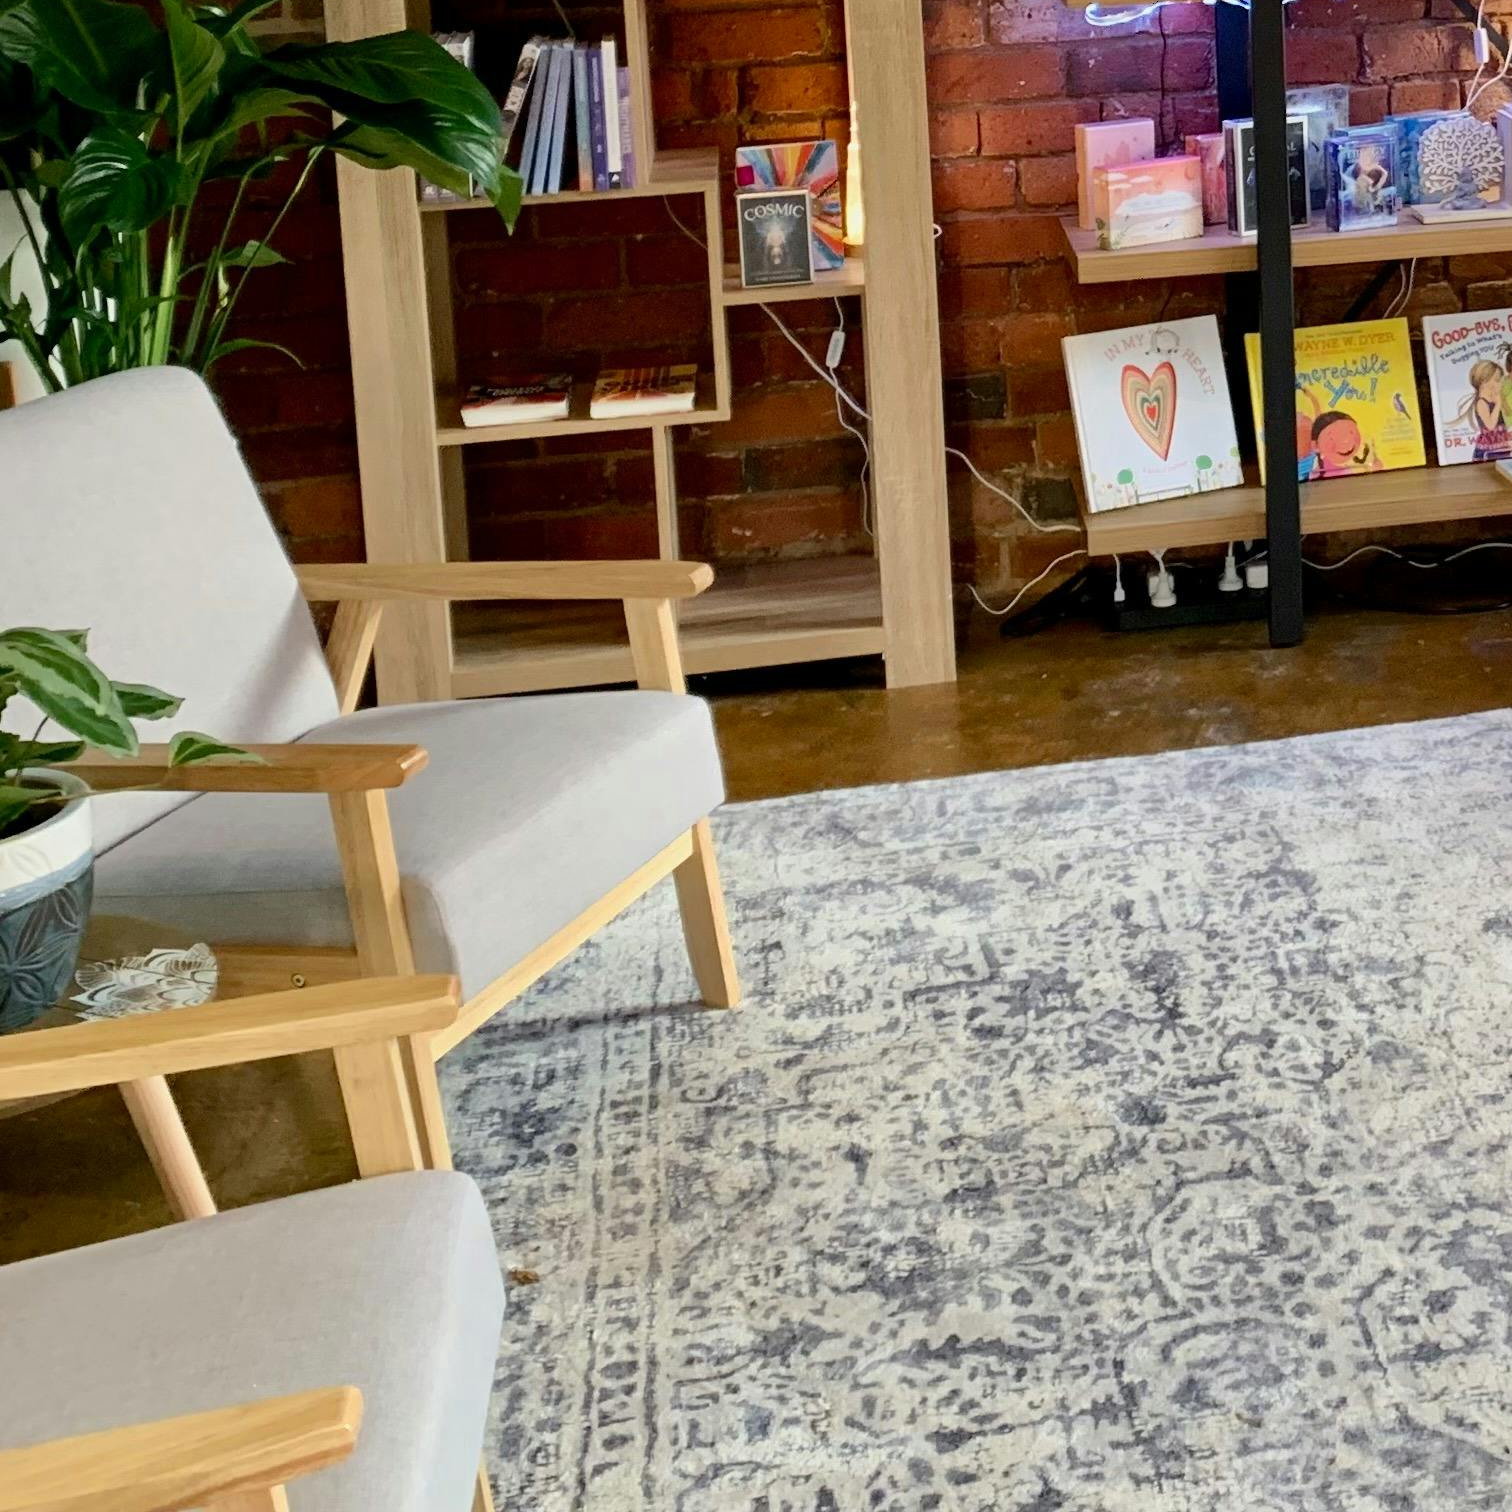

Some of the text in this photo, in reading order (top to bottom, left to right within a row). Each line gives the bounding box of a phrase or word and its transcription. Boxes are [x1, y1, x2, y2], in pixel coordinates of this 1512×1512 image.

[744, 203, 805, 222] COSMIC
[1359, 331, 1397, 345] DYER
[1104, 333, 1216, 396] IN MY HEART
[1443, 436, 1466, 448] DR.
